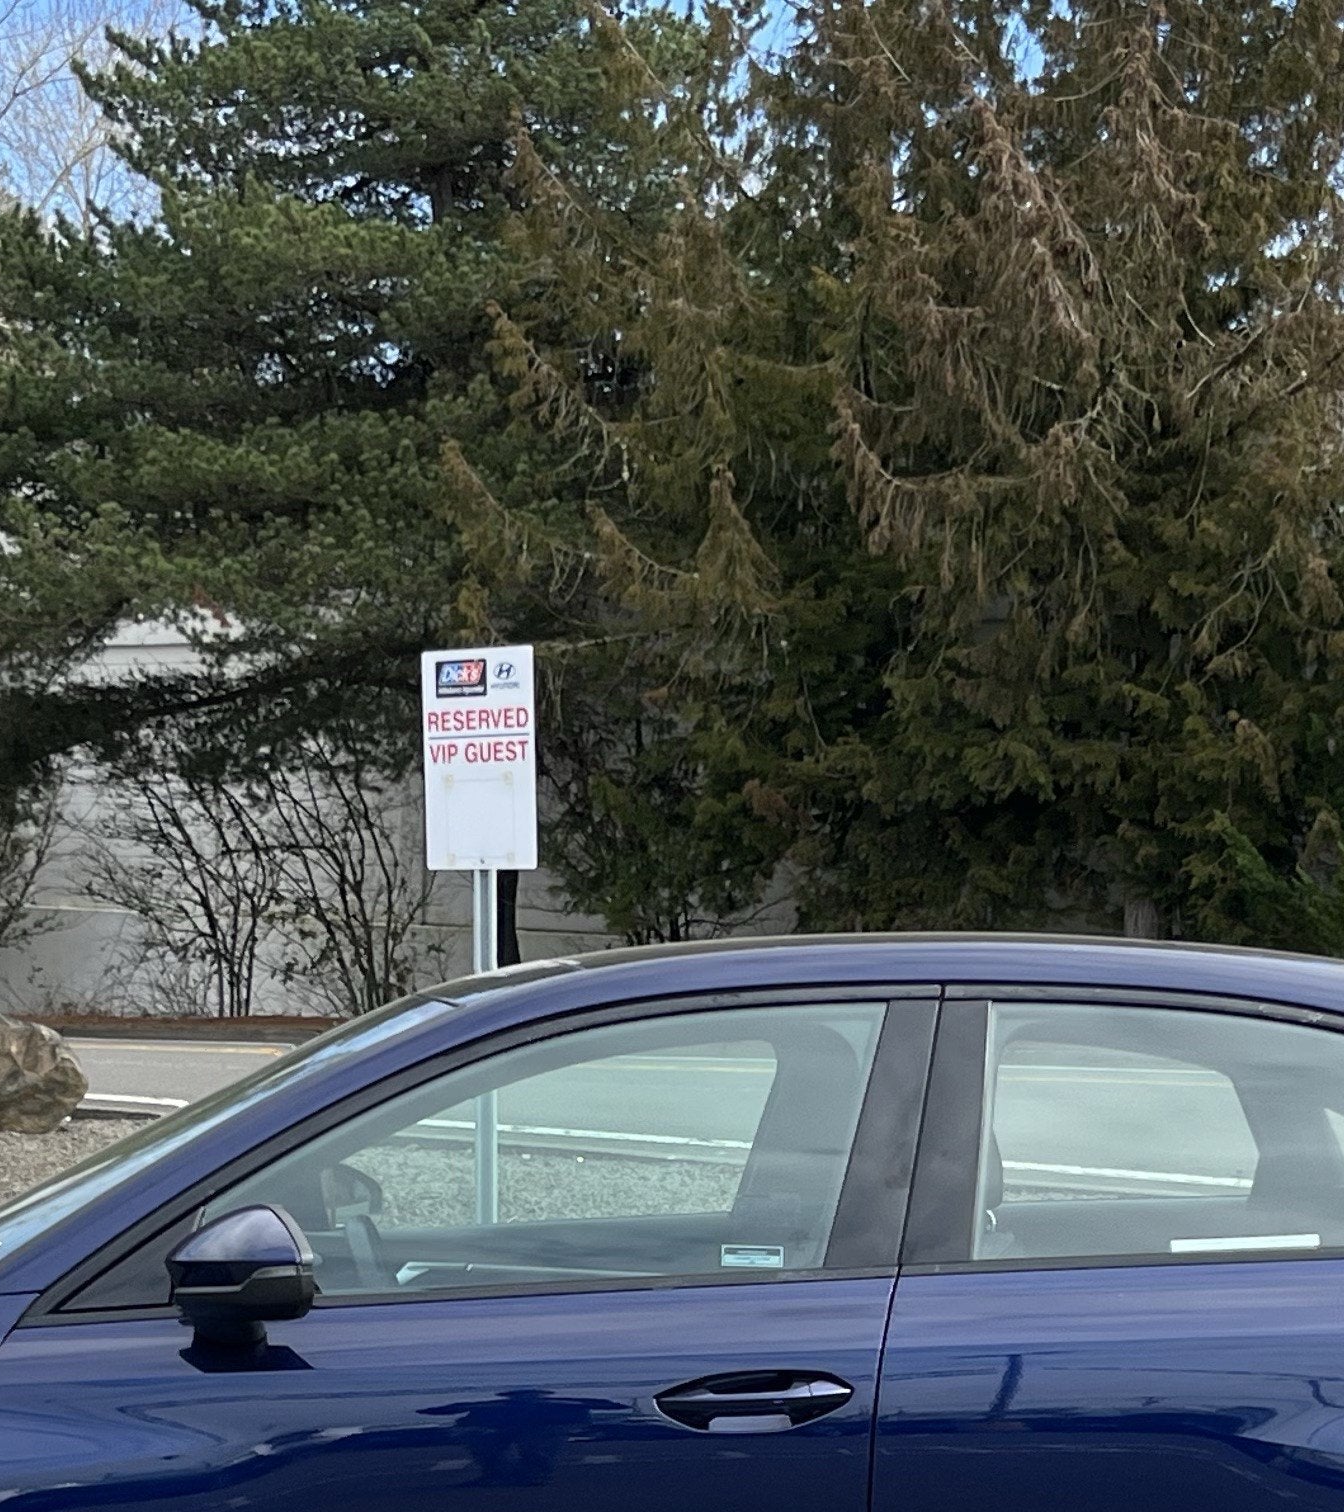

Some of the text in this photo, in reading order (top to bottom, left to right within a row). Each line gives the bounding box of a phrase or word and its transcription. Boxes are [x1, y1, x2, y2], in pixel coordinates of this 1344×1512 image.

[427, 707, 529, 732] RESERVED
[429, 740, 529, 764] VIP GUEST
